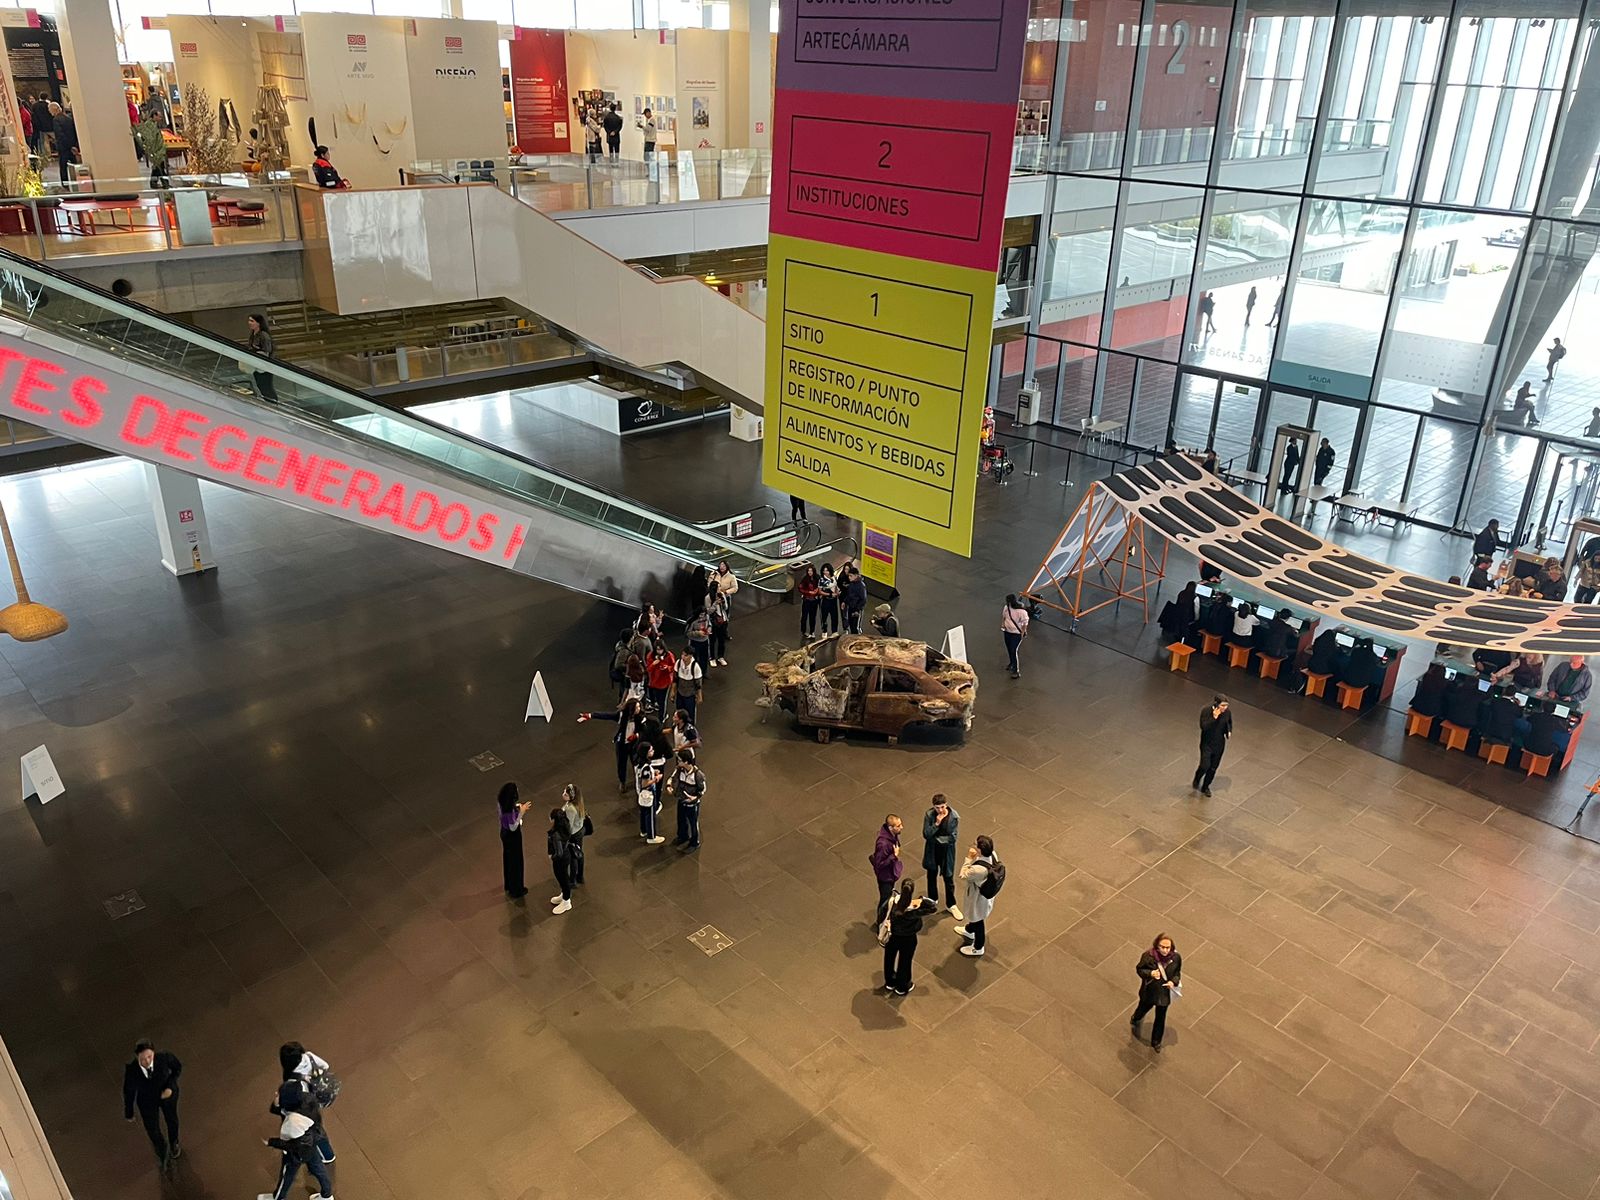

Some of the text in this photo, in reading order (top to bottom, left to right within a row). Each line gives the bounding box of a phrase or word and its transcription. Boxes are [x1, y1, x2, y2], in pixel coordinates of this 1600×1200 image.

[802, 28, 910, 52] ARTECÁMARA
[1166, 19, 1190, 75] 2
[877, 140, 893, 169] 2
[796, 184, 910, 217] INSTITUCIONES
[869, 292, 880, 318] 1
[789, 324, 824, 345] SITIO
[788, 360, 920, 408] REGISTRO / PUNTO
[1307, 374, 1332, 385] SALIDA
[787, 382, 910, 429] DE INFORMACIÓN
[785, 416, 945, 478] ALIMENTOS Y BEBIDAS
[119, 393, 500, 554] DEGENERADOS
[784, 449, 831, 477] SALIDA
